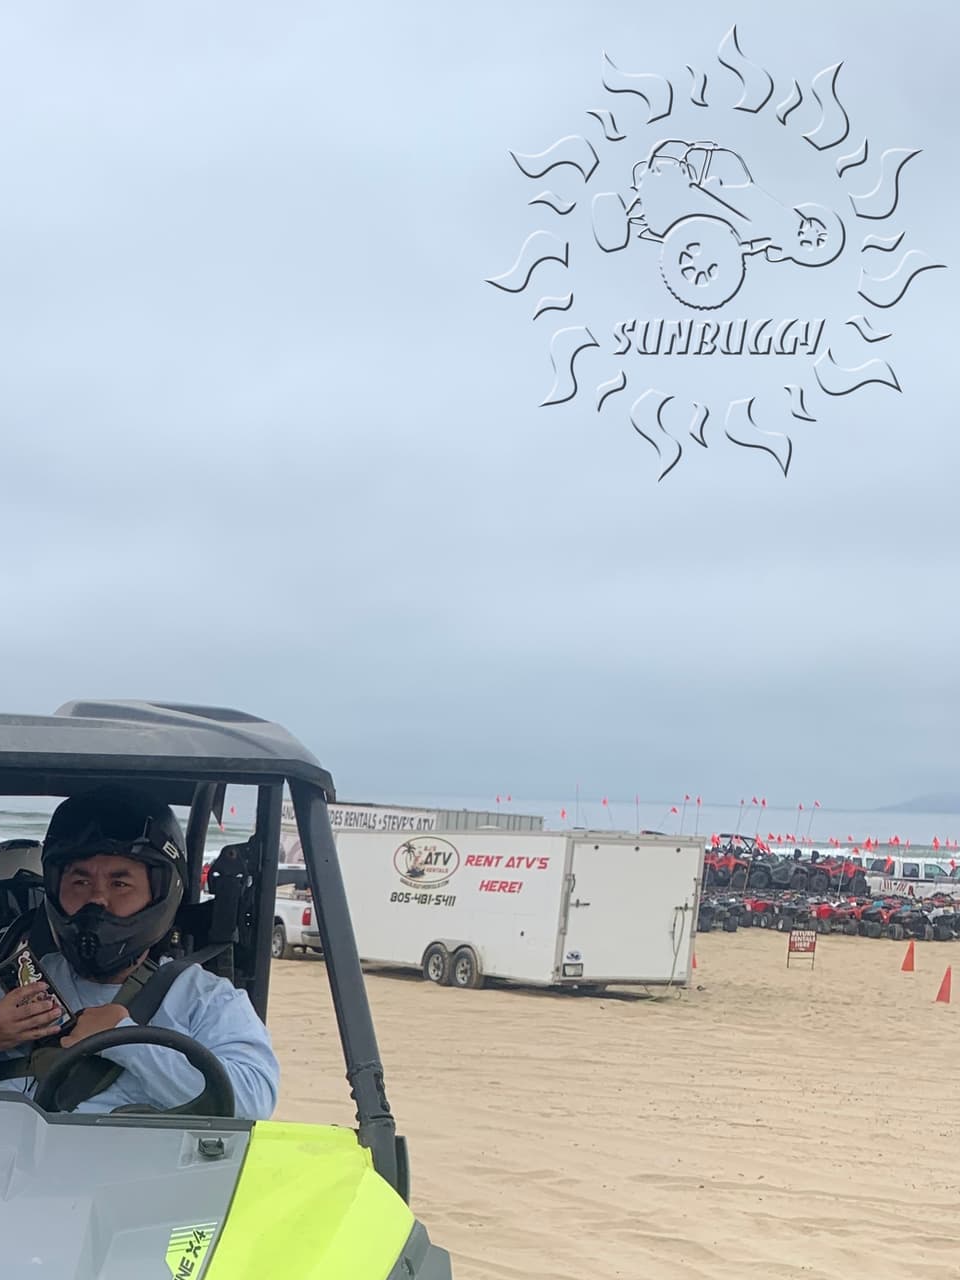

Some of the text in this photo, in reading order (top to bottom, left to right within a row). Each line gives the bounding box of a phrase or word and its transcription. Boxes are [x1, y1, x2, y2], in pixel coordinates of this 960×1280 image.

[344, 811, 377, 830] RENTALS
[424, 852, 452, 865] ATV
[465, 855, 550, 870] RENT ATV'S
[479, 880, 523, 893] HERE!
[390, 892, 457, 907] 805-481-5411
